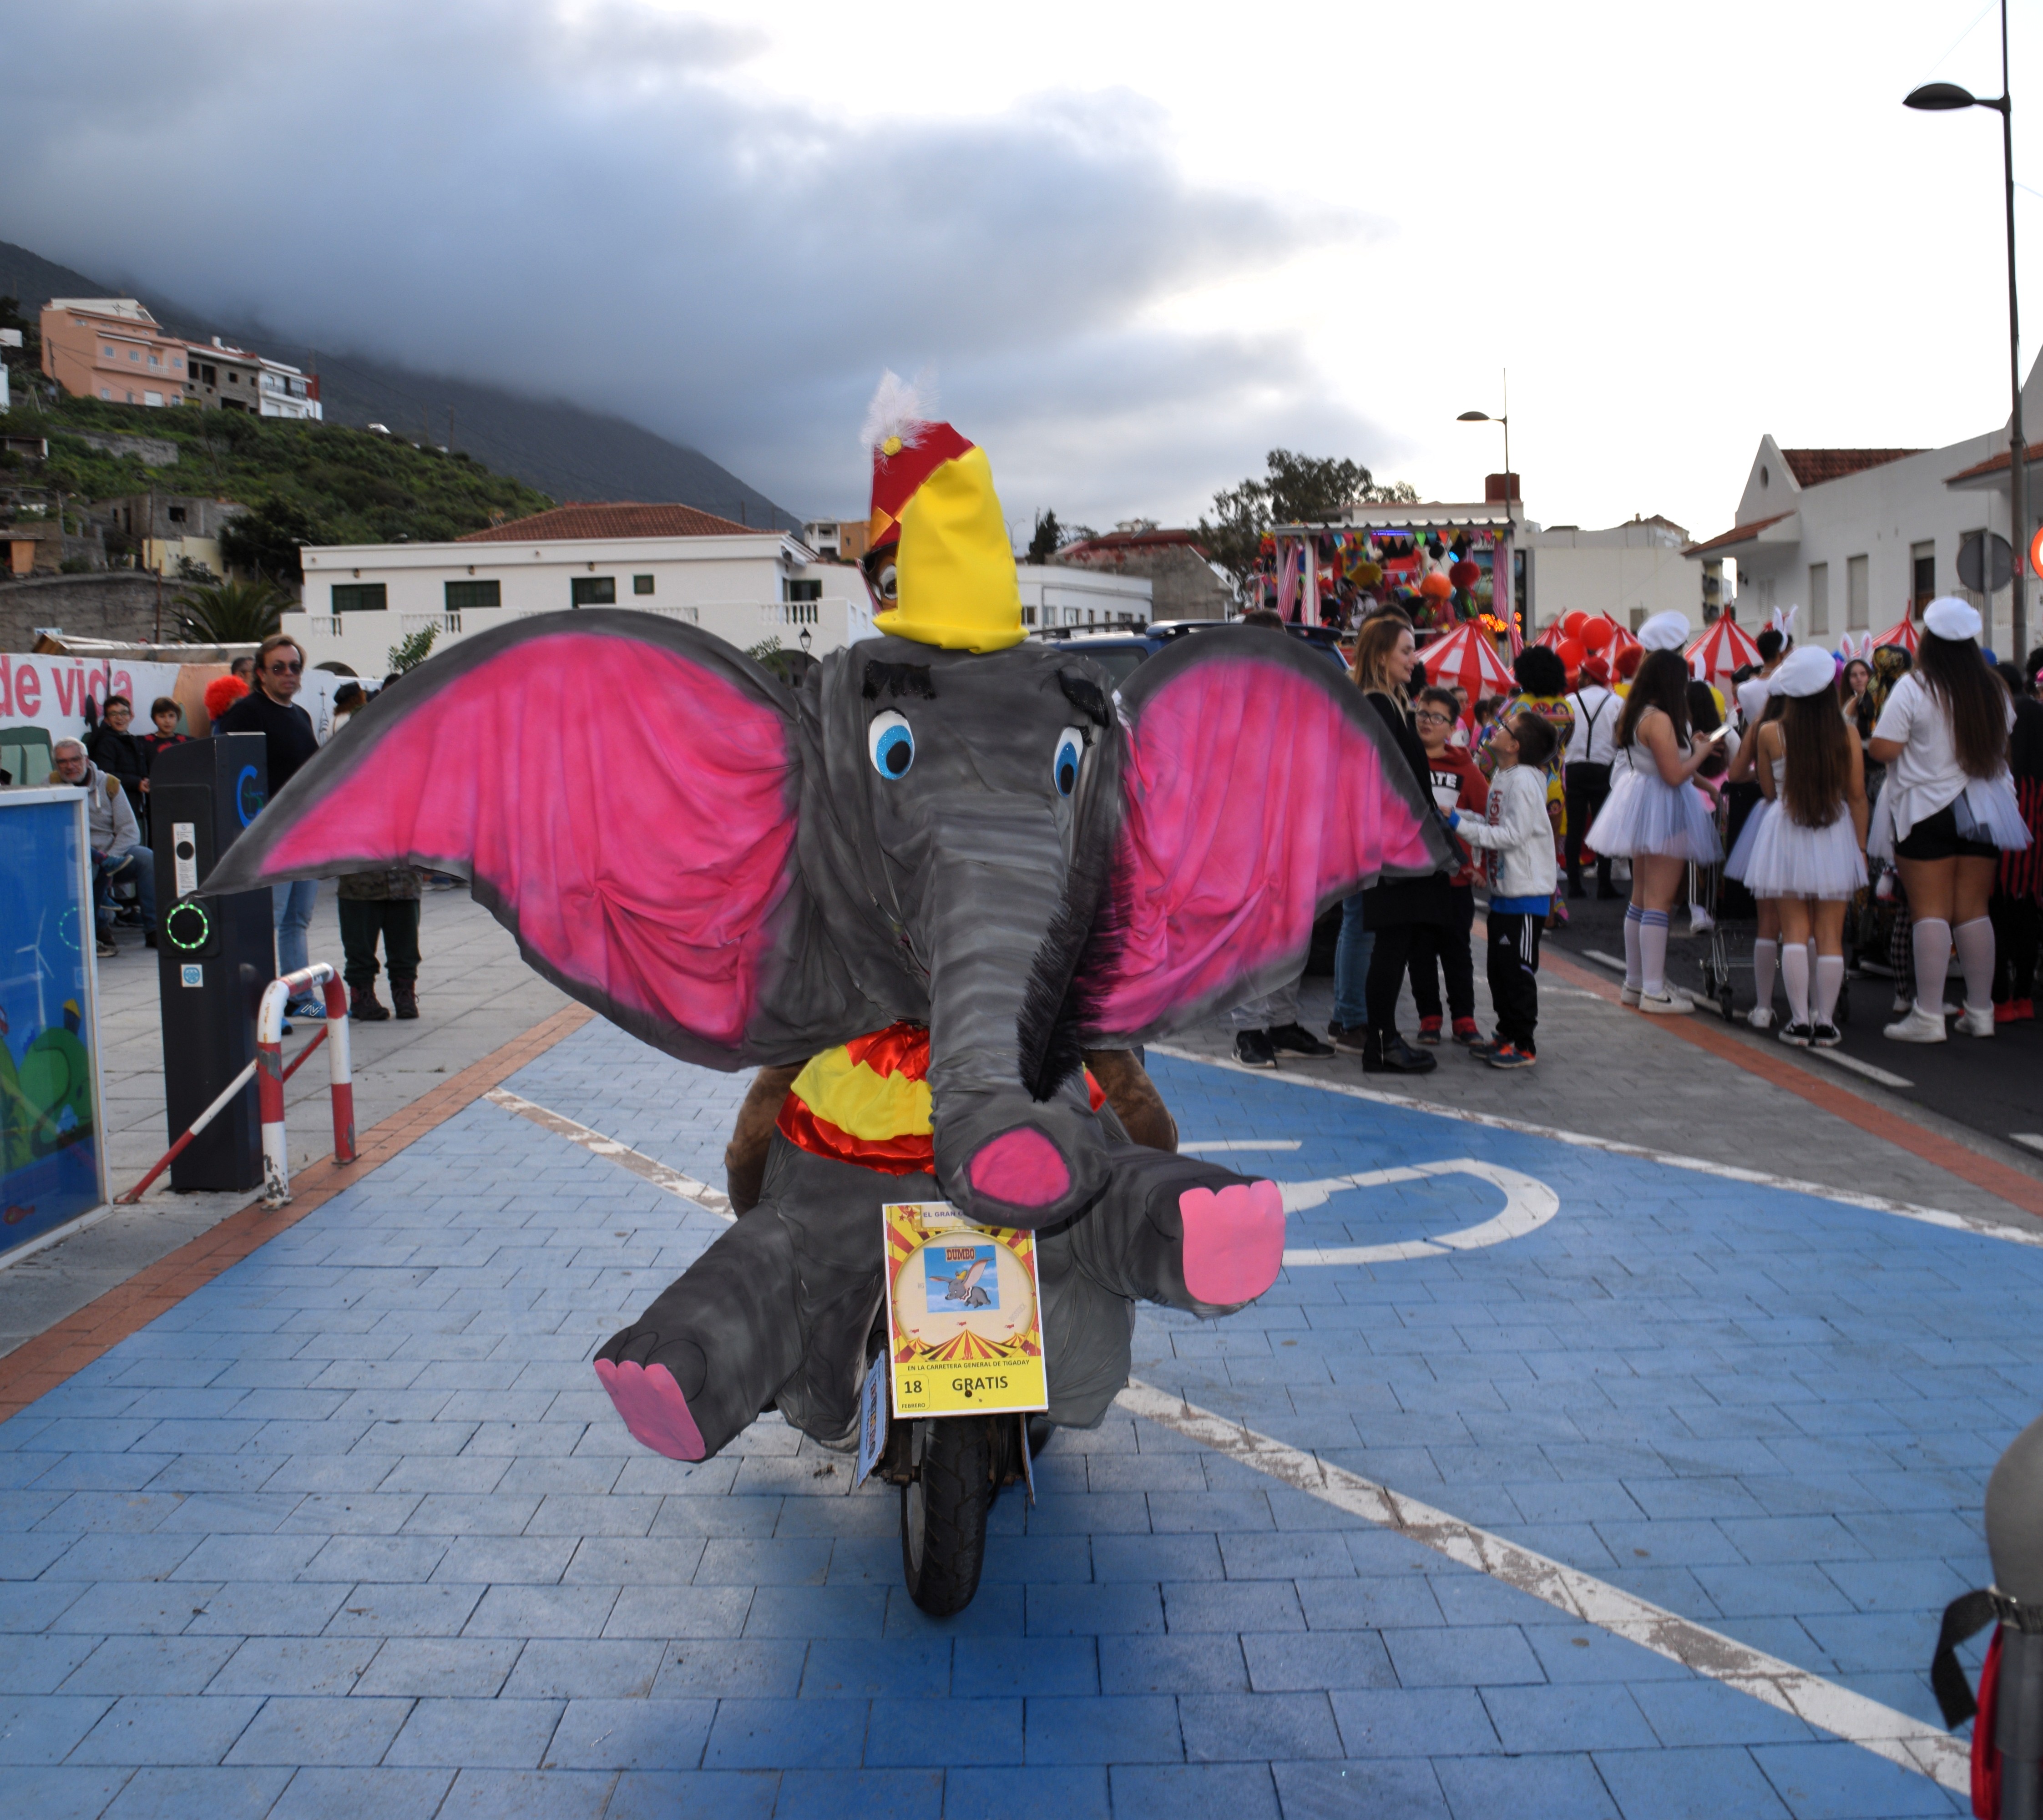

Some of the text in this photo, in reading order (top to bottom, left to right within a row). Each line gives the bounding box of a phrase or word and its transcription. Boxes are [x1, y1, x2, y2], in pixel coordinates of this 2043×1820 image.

[51, 657, 135, 719] vida
[946, 1248, 975, 1261] DUMBO
[904, 1375, 1008, 1394] 18 GRATIS
[868, 1379, 877, 1460] DUMBO
